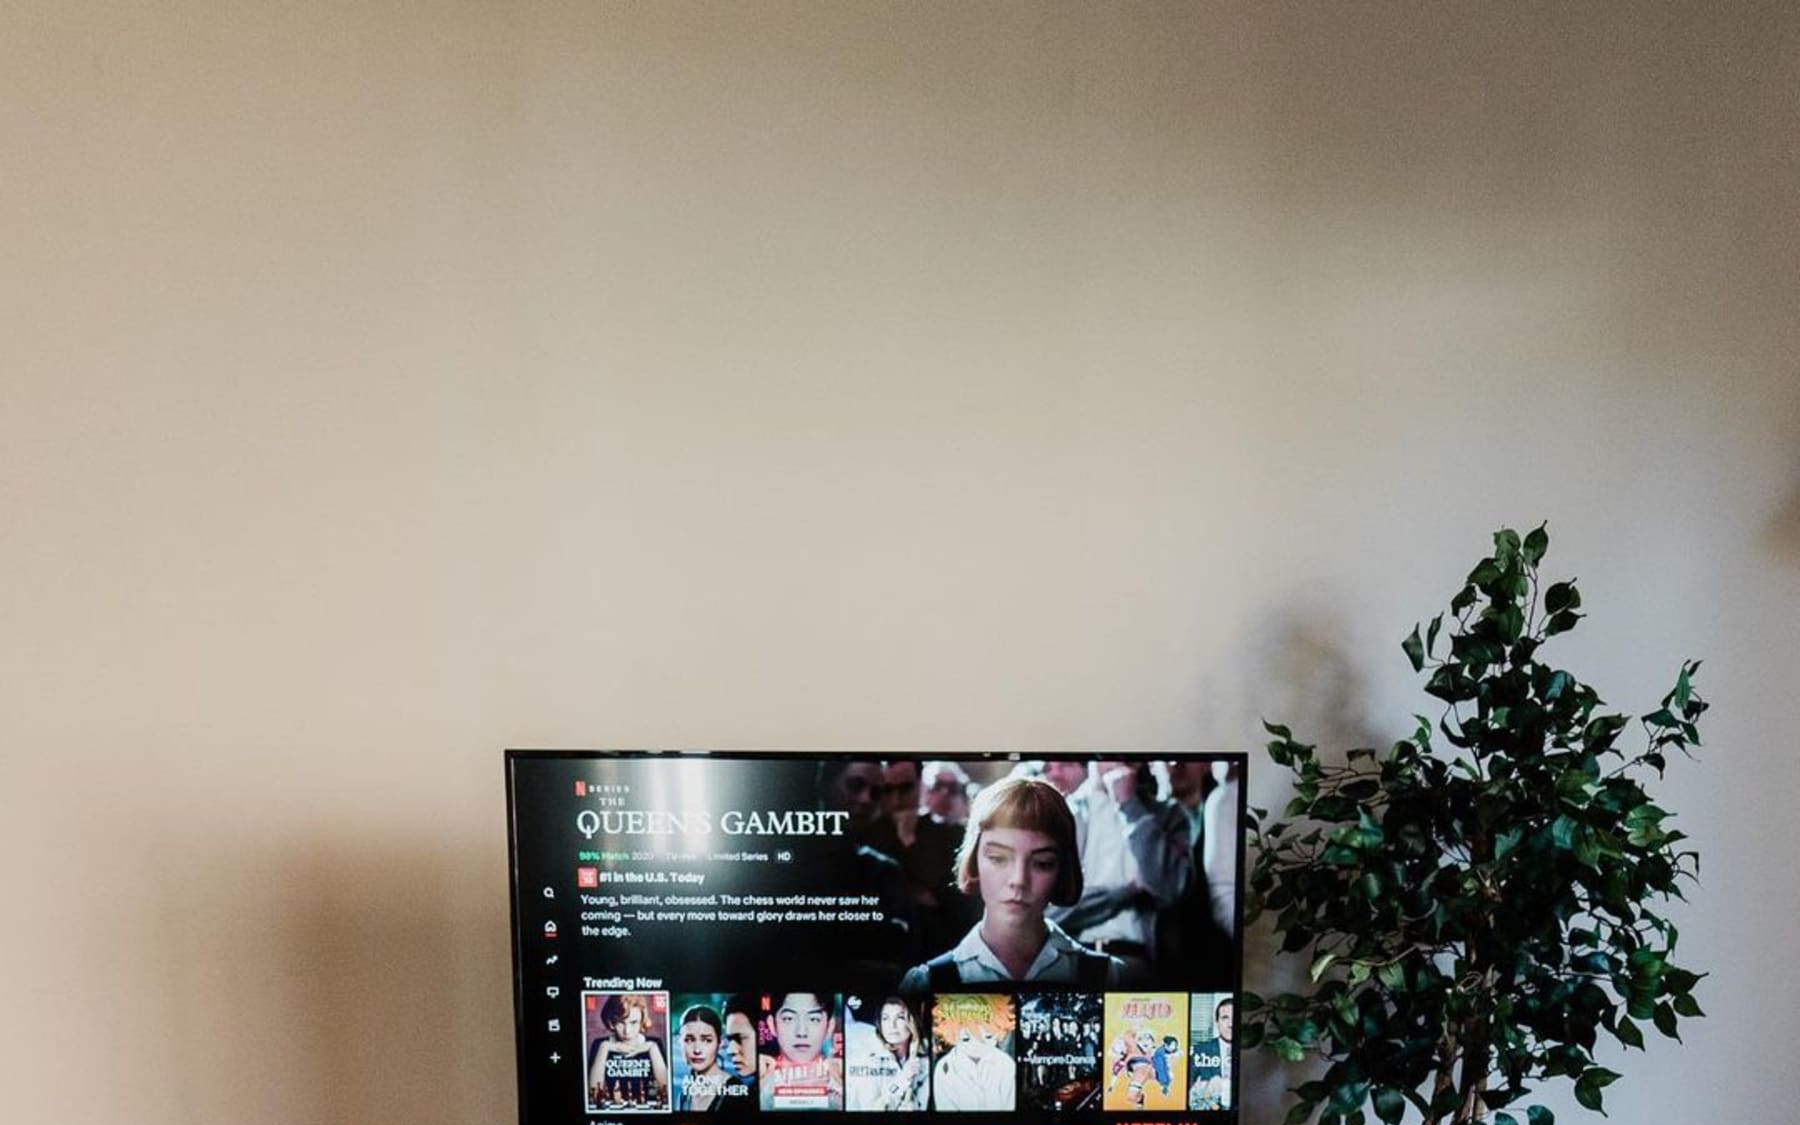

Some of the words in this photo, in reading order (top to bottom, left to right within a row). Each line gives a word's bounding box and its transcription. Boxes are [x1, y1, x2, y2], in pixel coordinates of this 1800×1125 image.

[598, 797, 625, 806] THE
[720, 811, 849, 836] GAMBIT
[741, 851, 769, 861] Series
[777, 851, 792, 861] HD
[600, 872, 612, 883] #1
[613, 872, 624, 883] in
[625, 872, 644, 883] the
[645, 872, 668, 883] U.S.
[671, 872, 705, 885] Today
[580, 894, 619, 907] Young,
[620, 894, 663, 907] brilliant,
[664, 894, 718, 905] obsessed.
[719, 894, 741, 905] The
[742, 895, 774, 906] chess
[775, 895, 806, 906] world
[807, 896, 837, 906] never
[838, 897, 860, 906] saw
[861, 894, 880, 906] her
[580, 911, 622, 923] coming
[637, 910, 655, 921] but
[656, 912, 685, 923] every
[687, 912, 716, 921] move
[717, 911, 755, 921] toward
[756, 911, 784, 923] glory
[784, 911, 817, 921] draws
[818, 911, 836, 921] her
[837, 911, 870, 921] closer
[872, 911, 884, 921] to
[581, 926, 600, 936] the
[601, 926, 631, 938] edge.
[583, 977, 635, 990] Trending
[636, 978, 663, 988] Now
[1194, 1053, 1221, 1067] the
[682, 1084, 749, 1096] TOGETHER
